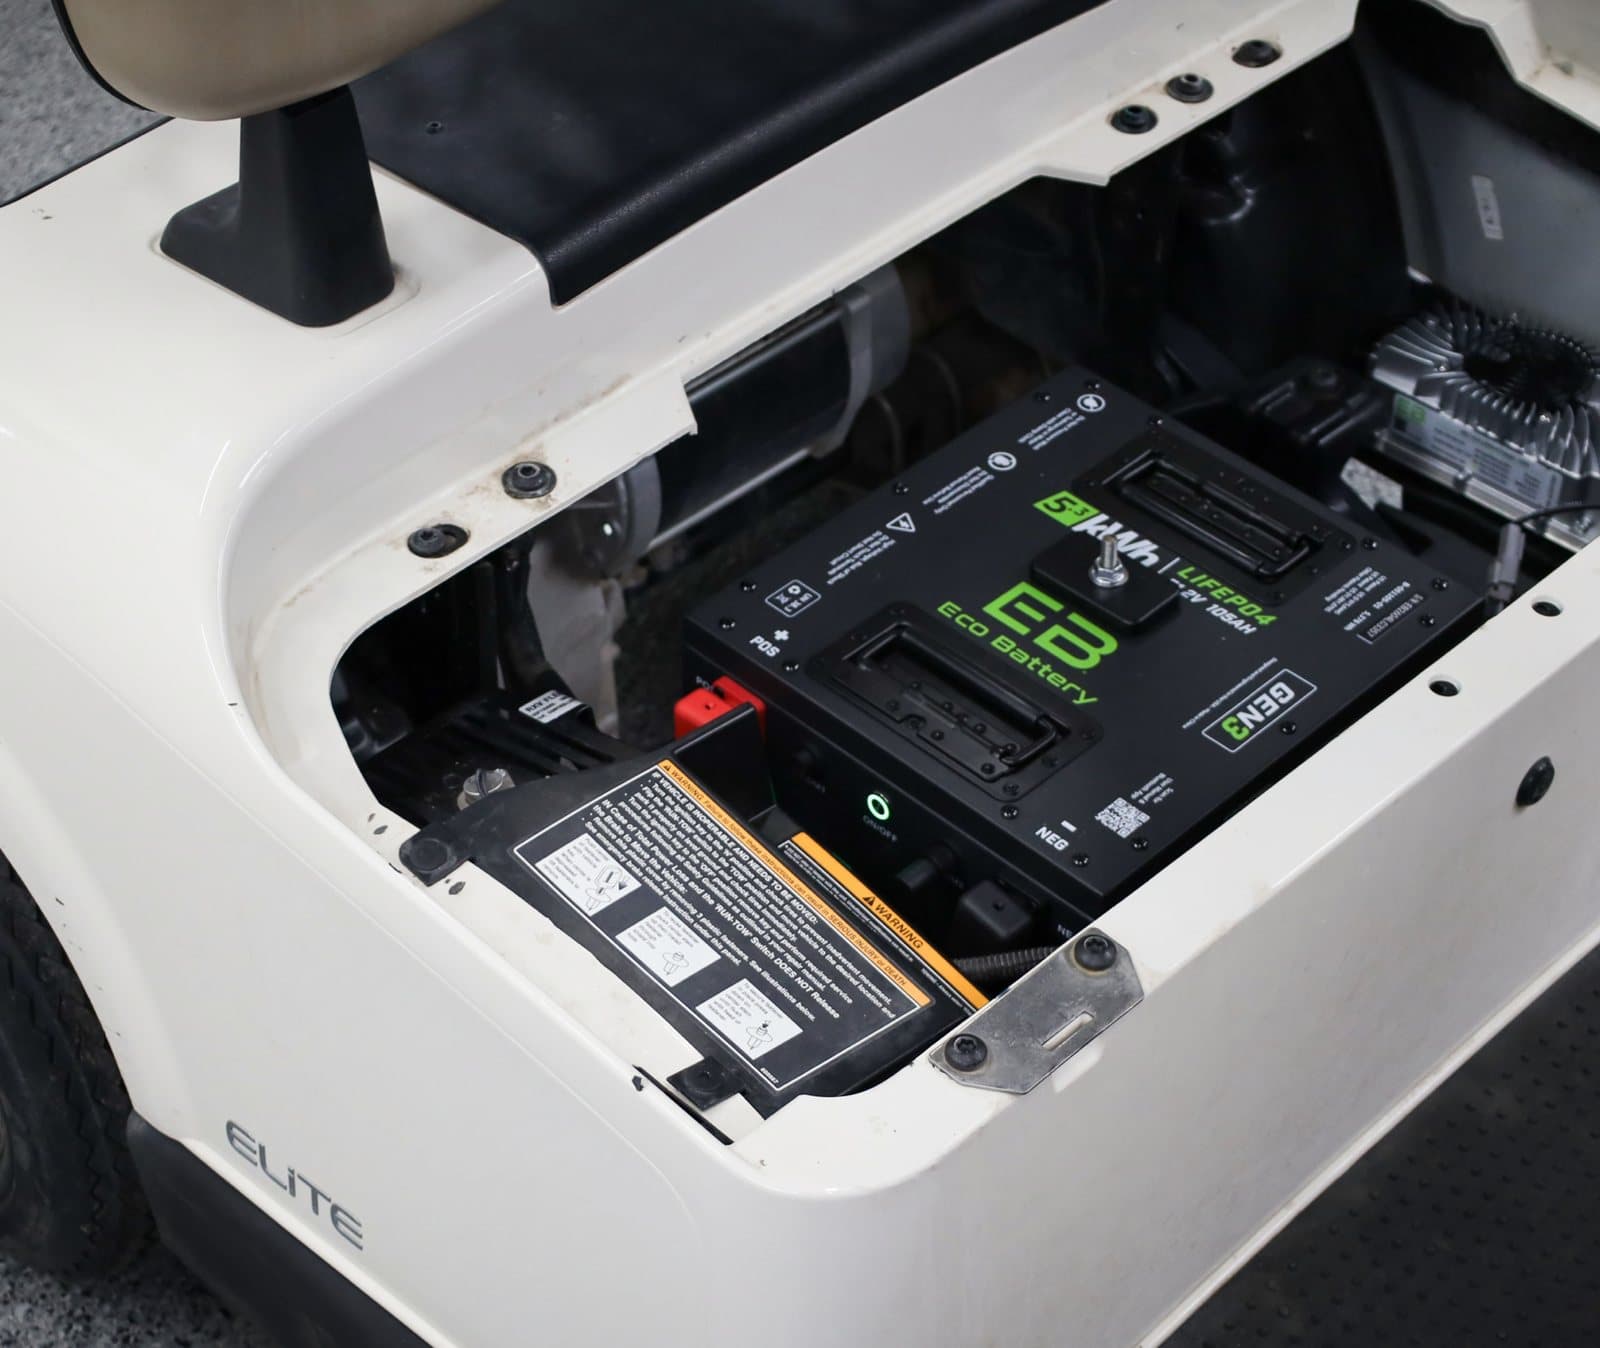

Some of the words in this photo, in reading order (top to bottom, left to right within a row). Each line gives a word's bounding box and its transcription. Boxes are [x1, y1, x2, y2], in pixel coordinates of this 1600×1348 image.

[1072, 510, 1159, 566] kWh
[749, 635, 780, 657] POS
[937, 601, 989, 637] Eco
[991, 635, 1097, 704] Battery
[982, 582, 1117, 669] EB
[1206, 604, 1257, 634] 105AH
[1221, 682, 1295, 740] GEN3
[592, 804, 605, 816] the
[603, 815, 624, 835] Brake
[622, 833, 632, 842] to
[630, 840, 650, 859] Move
[648, 857, 661, 869] the
[660, 867, 687, 893] Vehicle:
[633, 792, 649, 805] park
[675, 830, 685, 839] on
[683, 837, 700, 851] level
[696, 850, 721, 870] ground
[718, 869, 732, 881] and
[659, 777, 688, 804] VEHICLE
[685, 802, 695, 811] IS
[692, 809, 735, 847] INOPERABLE
[732, 847, 749, 861] AND
[747, 859, 772, 881] NEEDS
[770, 879, 782, 890] TO
[780, 889, 793, 900] BE
[790, 898, 817, 924] MOVED:
[1035, 826, 1069, 851] NEG
[584, 821, 597, 833] See
[595, 832, 627, 861] emergency
[625, 860, 643, 876] brake
[641, 875, 664, 895] release
[693, 922, 712, 938] under
[710, 937, 723, 949] this
[592, 816, 616, 839] Remove
[615, 837, 627, 850] this
[625, 849, 646, 867] plastic
[645, 866, 663, 881] cover
[660, 880, 674, 889] by
[669, 888, 697, 914] removing
[700, 917, 721, 936] plastic
[748, 959, 762, 972] See
[601, 799, 613, 808] IN
[610, 807, 627, 824] Case
[626, 823, 637, 831] of
[634, 829, 653, 847] Total
[650, 845, 673, 865] Power
[671, 864, 689, 882] Loss
[688, 881, 704, 894] and
[701, 892, 714, 904] the
[750, 936, 774, 959] Switch
[773, 957, 797, 978] DOES
[794, 976, 813, 991] NOT
[810, 991, 839, 1018] Release
[628, 796, 641, 810] Turn
[640, 808, 651, 819] the
[649, 817, 672, 839] ignition
[670, 837, 683, 849] key
[681, 847, 689, 855] to
[688, 853, 699, 864] the
[736, 898, 759, 919] remove
[758, 917, 771, 929] key
[769, 928, 784, 940] and
[780, 939, 806, 960] perform
[804, 960, 832, 983] required
[829, 983, 852, 1003] service
[641, 786, 654, 798] Flip
[652, 796, 664, 806] the
[692, 834, 712, 852] switch
[711, 850, 719, 858] to
[718, 856, 729, 867] the
[743, 881, 769, 904] position
[768, 903, 782, 915] and
[780, 914, 798, 930] move
[797, 929, 819, 949] vehicle
[817, 947, 825, 955] to
[824, 954, 836, 965] the
[835, 964, 860, 985] desired
[857, 983, 882, 1007] location
[881, 1006, 896, 1018] and
[651, 782, 665, 796] Turn
[664, 795, 675, 805] the
[673, 803, 696, 825] ignition
[694, 823, 707, 835] key
[705, 833, 713, 841] to
[712, 839, 723, 850] the
[729, 856, 754, 878] position
[753, 878, 767, 889] and
[783, 904, 798, 918] tires
[796, 916, 804, 924] to
[802, 923, 828, 944] prevent
[825, 943, 860, 975] inadvertent
[858, 974, 891, 1004] movement.
[874, 903, 925, 950] WARNING
[731, 905, 740, 913] as
[739, 912, 765, 935] outlined
[762, 932, 771, 941] in
[768, 939, 785, 952] your
[783, 952, 802, 968] repair
[827, 913, 860, 941] SERIOUS
[854, 938, 881, 960] INJURY
